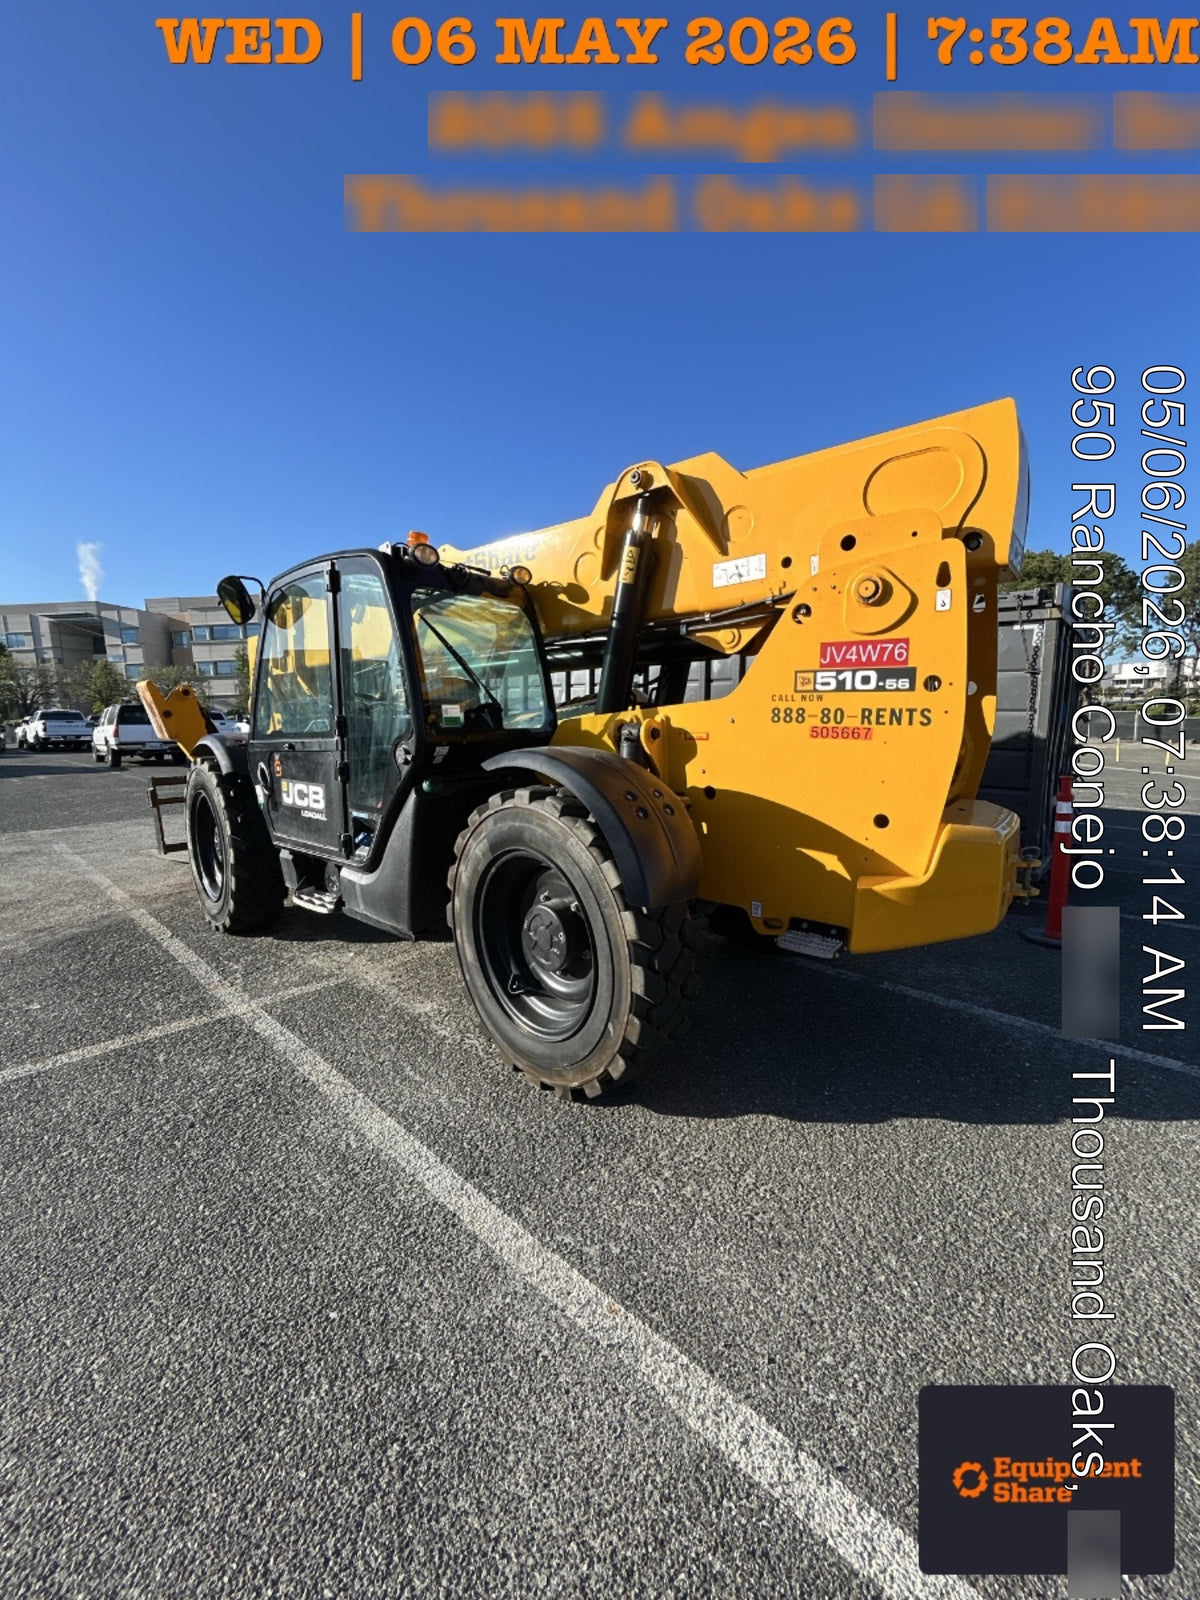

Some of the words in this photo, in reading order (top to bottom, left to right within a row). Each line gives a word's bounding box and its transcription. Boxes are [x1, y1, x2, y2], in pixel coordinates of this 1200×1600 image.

[820, 642, 908, 665] JV4W76
[771, 693, 796, 703] CALL
[801, 693, 824, 703] NOW
[771, 707, 932, 727] 888-80-RENTS
[810, 726, 872, 740] 505667
[281, 780, 326, 811] JCB
